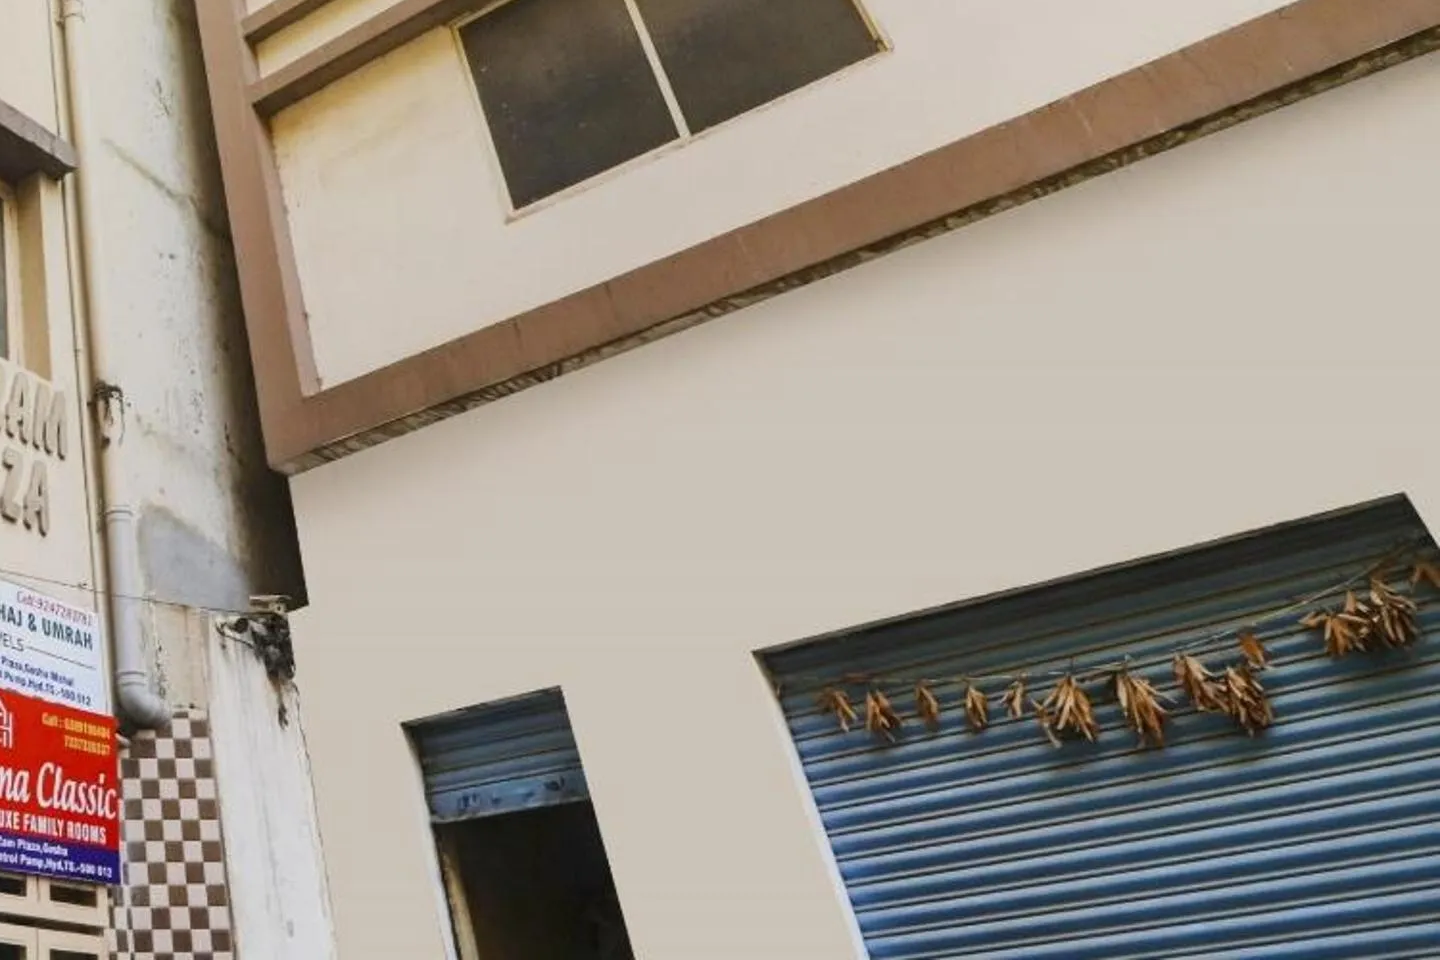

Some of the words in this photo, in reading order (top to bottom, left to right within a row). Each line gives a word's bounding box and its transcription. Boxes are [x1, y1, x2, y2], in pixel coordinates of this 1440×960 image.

[28, 613, 38, 632] &
[41, 617, 94, 651] UMRAH
[36, 761, 118, 820] Classic
[22, 813, 65, 838] FAMILY
[66, 820, 107, 846] ROOMS
